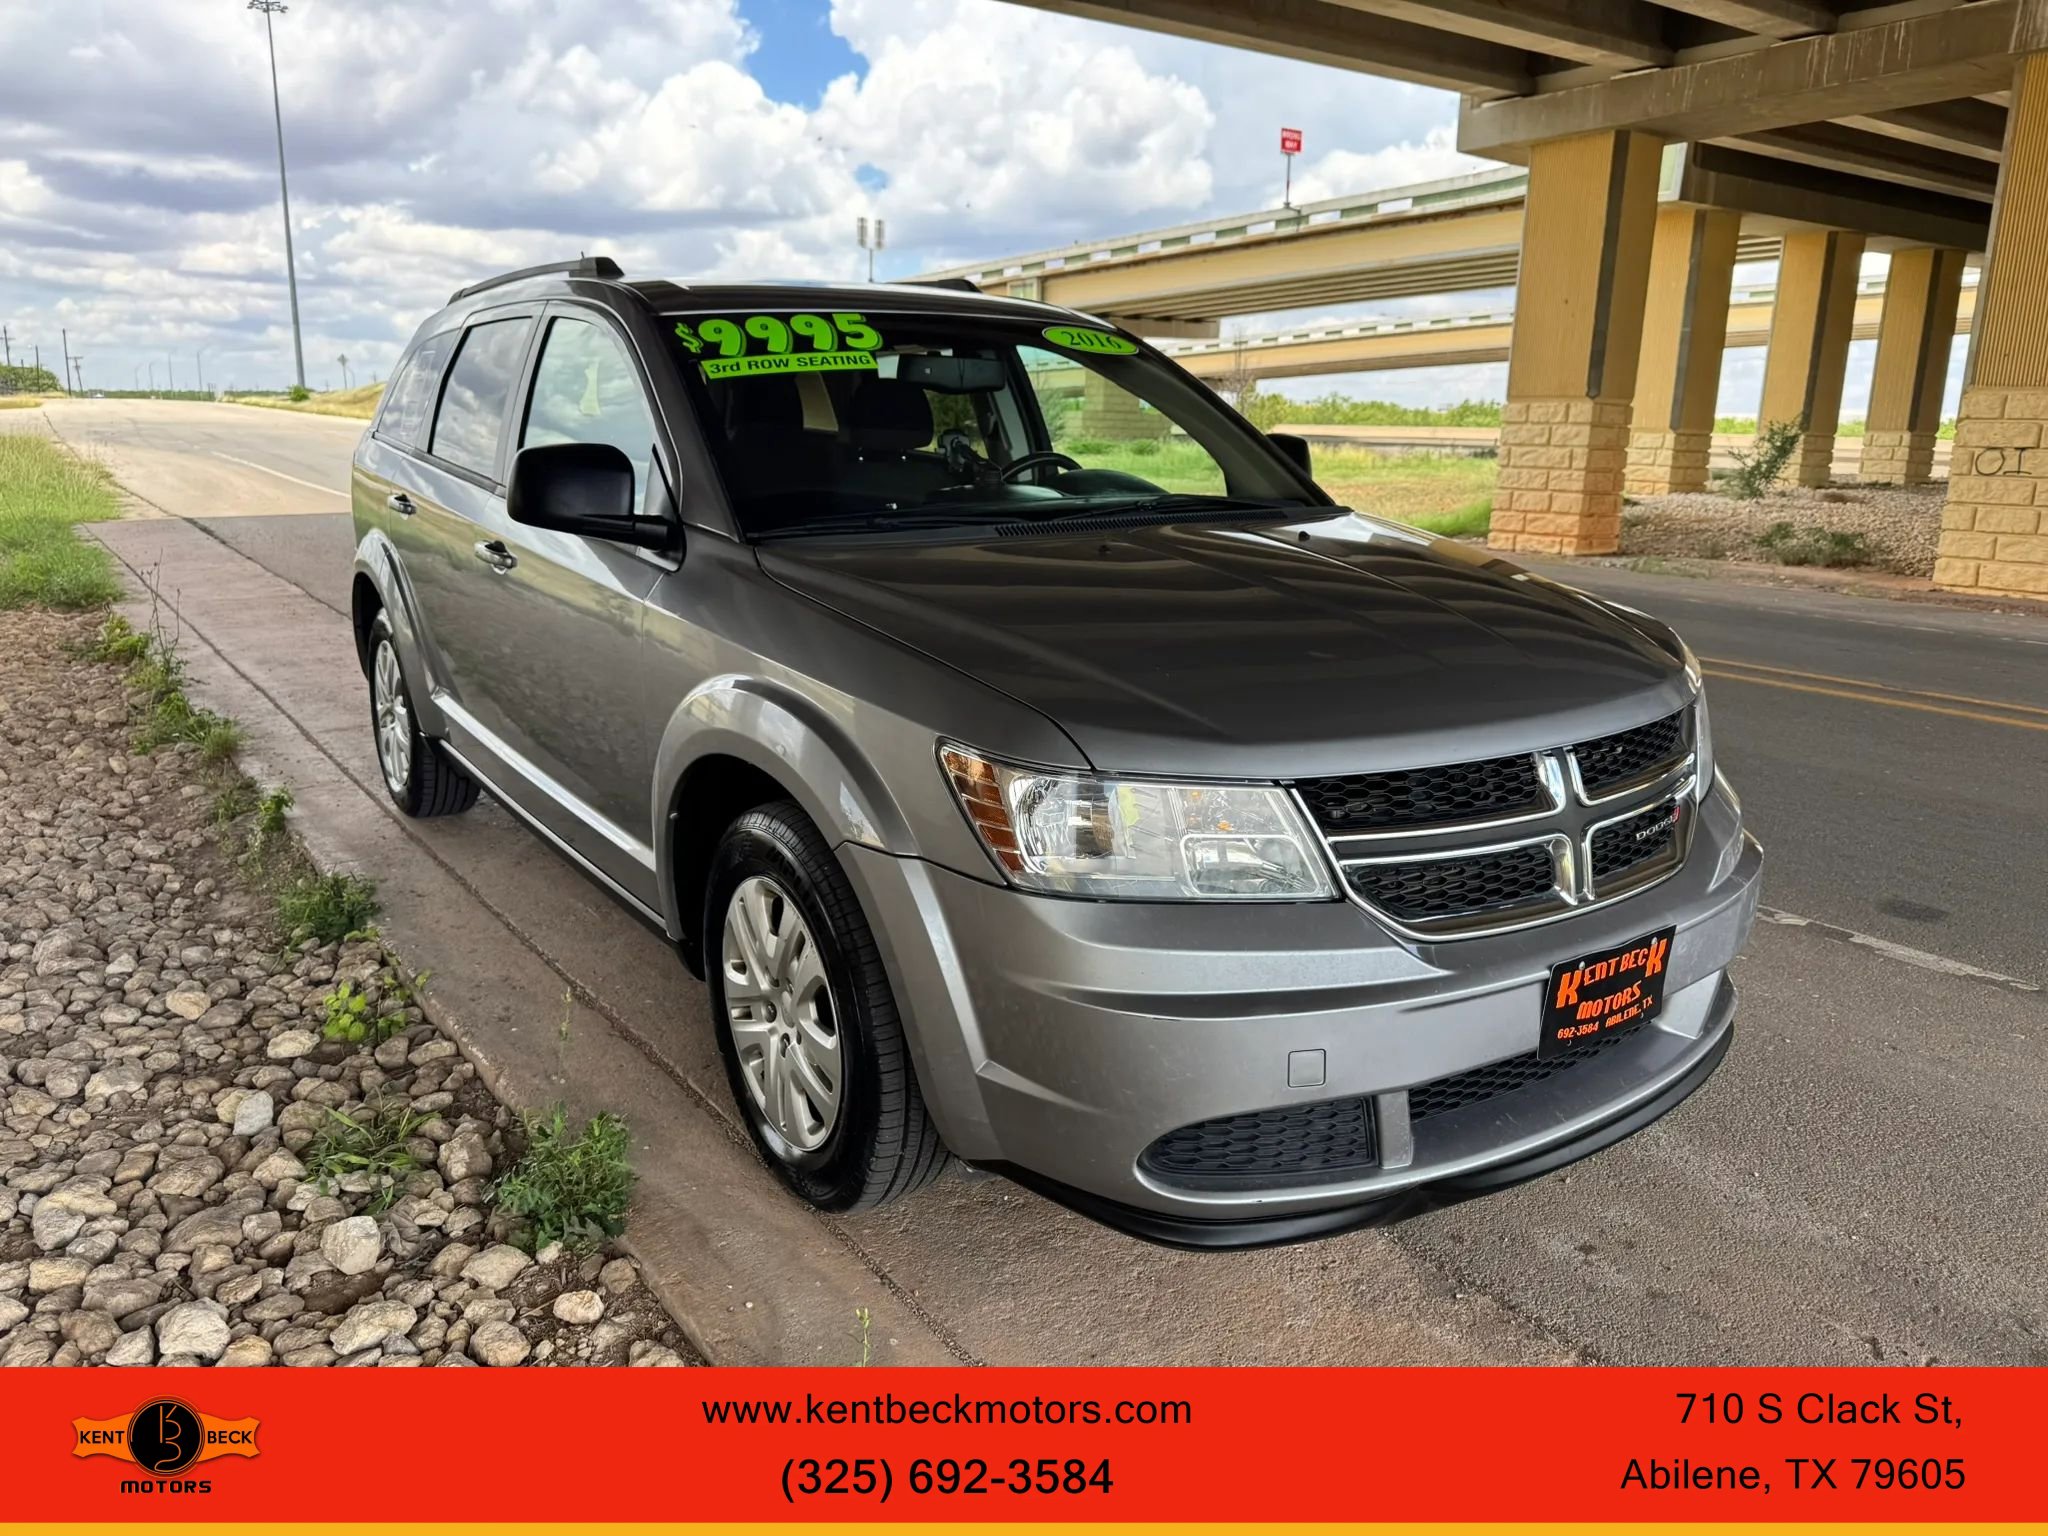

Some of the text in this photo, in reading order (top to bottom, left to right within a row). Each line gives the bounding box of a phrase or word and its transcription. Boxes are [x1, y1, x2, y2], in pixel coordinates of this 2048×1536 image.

[674, 313, 883, 356] $9995
[1060, 331, 1122, 349] 2016
[709, 354, 871, 375] 3rd ROW SEATING
[1556, 938, 1668, 1009] KENT BECK
[1557, 1021, 1600, 1039] 692-3584
[1642, 994, 1653, 1010] TX
[1576, 980, 1642, 1020] MOTORS
